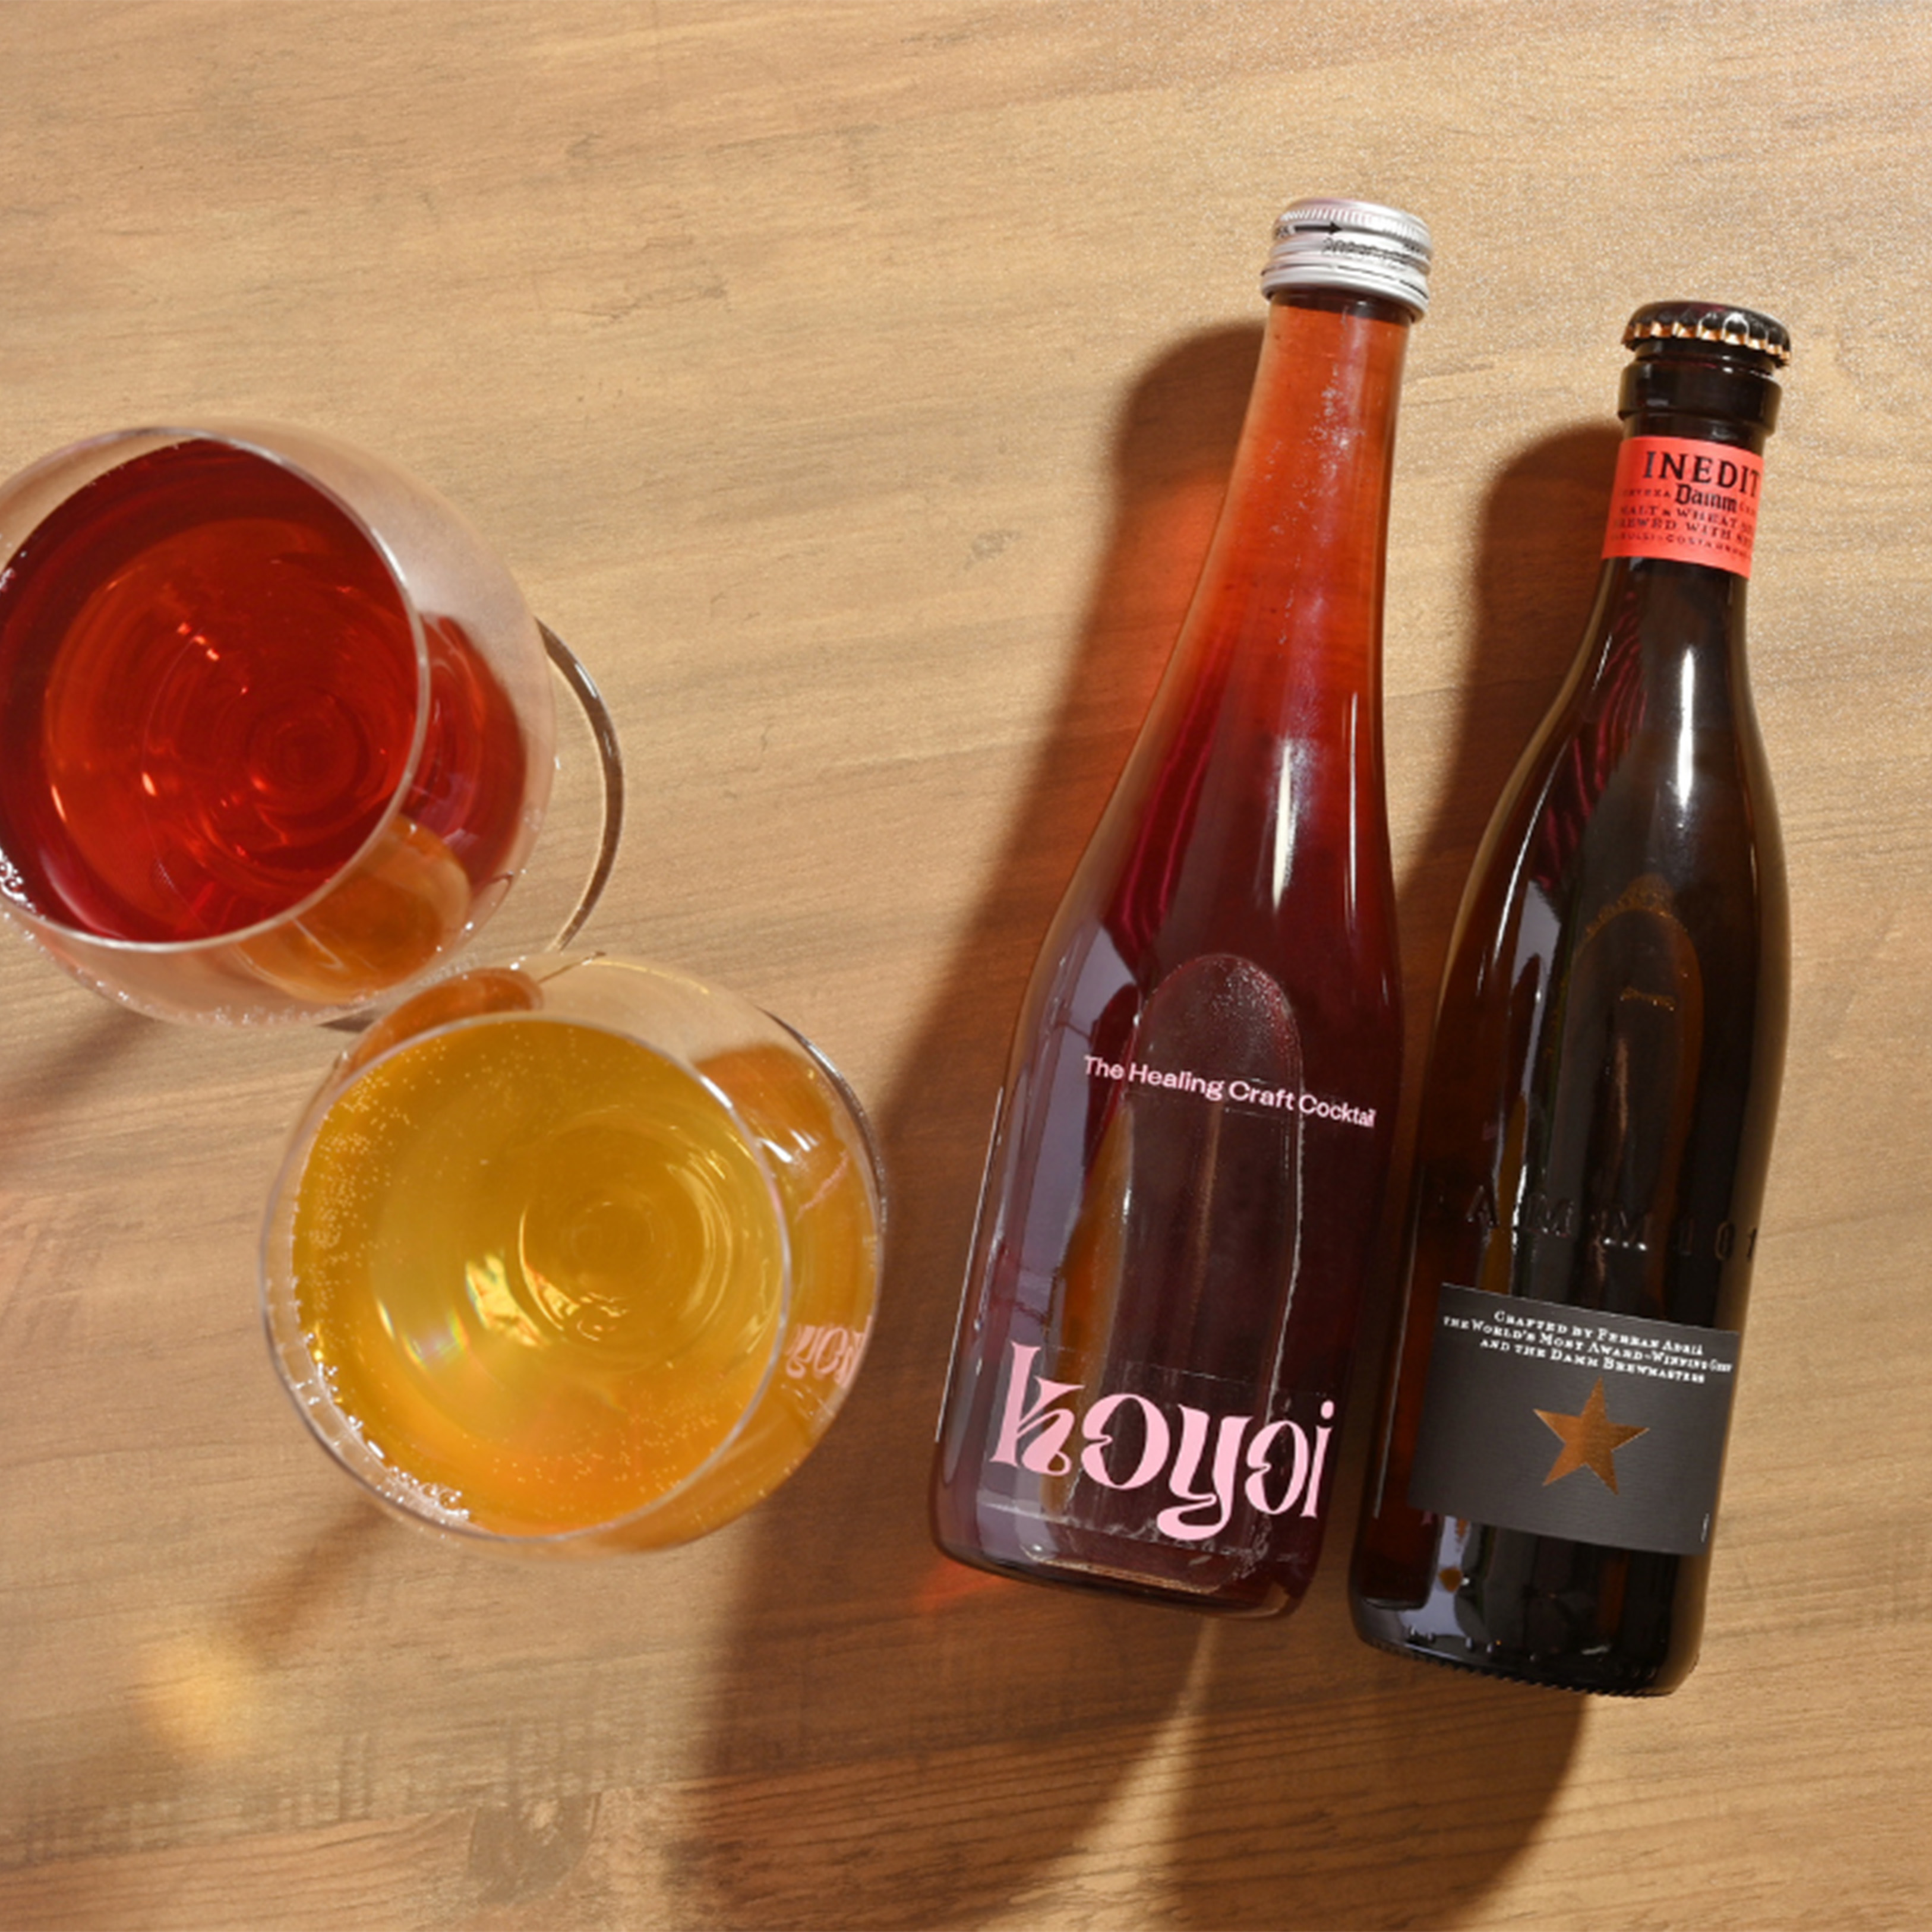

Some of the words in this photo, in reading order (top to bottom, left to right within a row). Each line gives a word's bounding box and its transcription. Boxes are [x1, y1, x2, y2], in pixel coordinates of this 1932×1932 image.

[1643, 451, 1760, 497] INEDIT
[1675, 483, 1738, 513] Damm
[1677, 507, 1737, 528] WHEAT
[1686, 522, 1731, 540] WITH
[1083, 1056, 1124, 1079] The
[1128, 1062, 1225, 1101] Healing
[1228, 1080, 1295, 1110] Craft
[1299, 1094, 1377, 1128] Cocktail
[1443, 1316, 1469, 1329] THE
[1472, 1318, 1536, 1341] WORLD'S
[1539, 1332, 1584, 1350] MOST
[1494, 1310, 1567, 1334] CRAFTED
[1571, 1325, 1593, 1338] BY
[1598, 1328, 1659, 1348] FERRAN
[1479, 1338, 1511, 1352] AND
[1514, 1344, 1546, 1358] THE
[1550, 1348, 1598, 1367] DAMM
[989, 1340, 1334, 1540] koyoi
